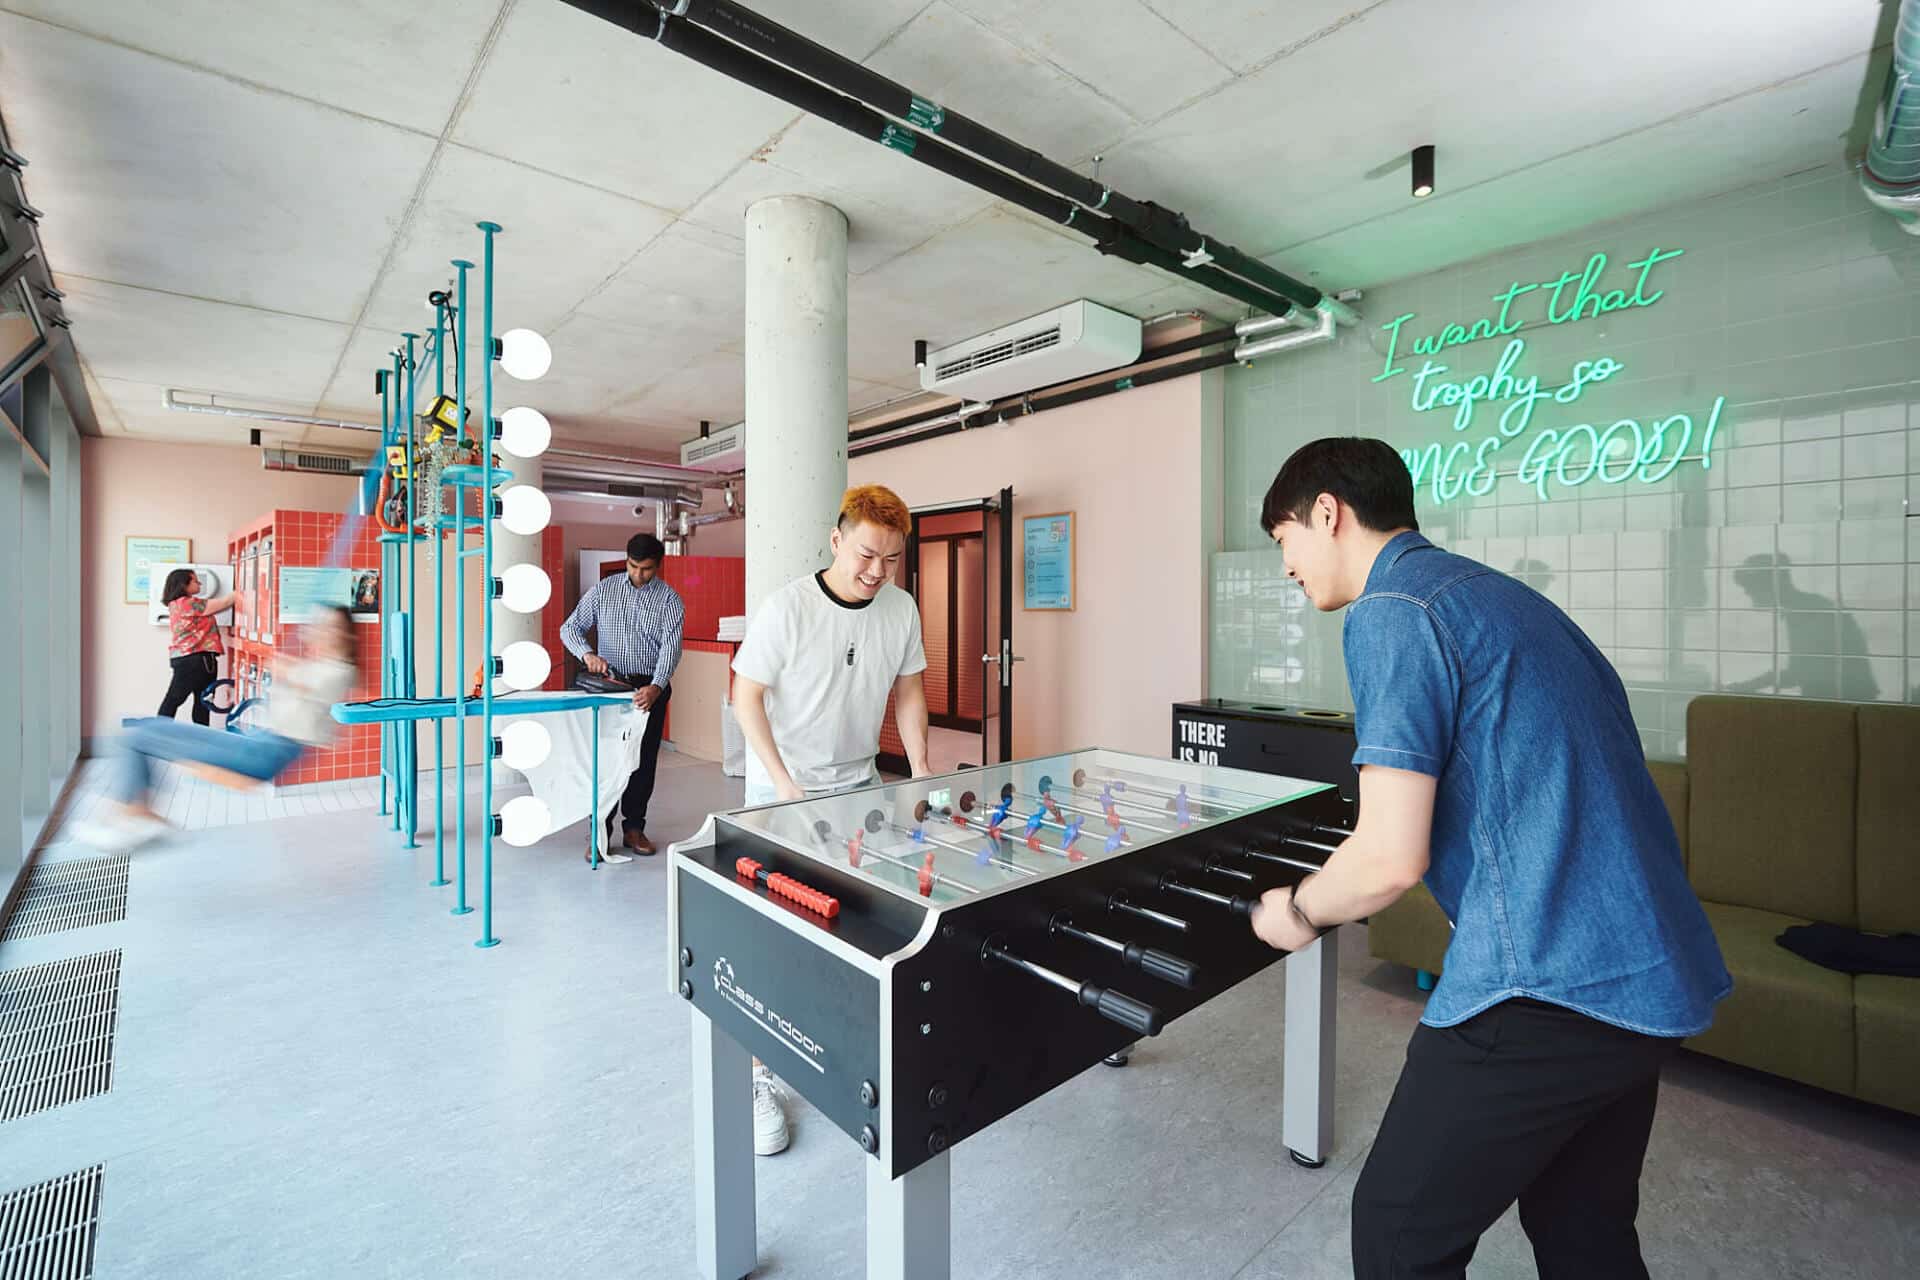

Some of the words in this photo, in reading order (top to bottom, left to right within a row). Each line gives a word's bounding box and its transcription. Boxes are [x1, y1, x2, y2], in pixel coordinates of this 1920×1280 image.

[1371, 313, 1416, 384] I
[1413, 282, 1538, 355] want
[1542, 247, 1684, 324] that
[1411, 338, 1553, 438] trophy
[1555, 356, 1625, 404] so
[1400, 436, 1501, 505] NCE
[1518, 397, 1724, 500] GOOD!
[1179, 720, 1226, 747] THERE
[1180, 747, 1194, 763] IS
[1199, 749, 1218, 766] NO
